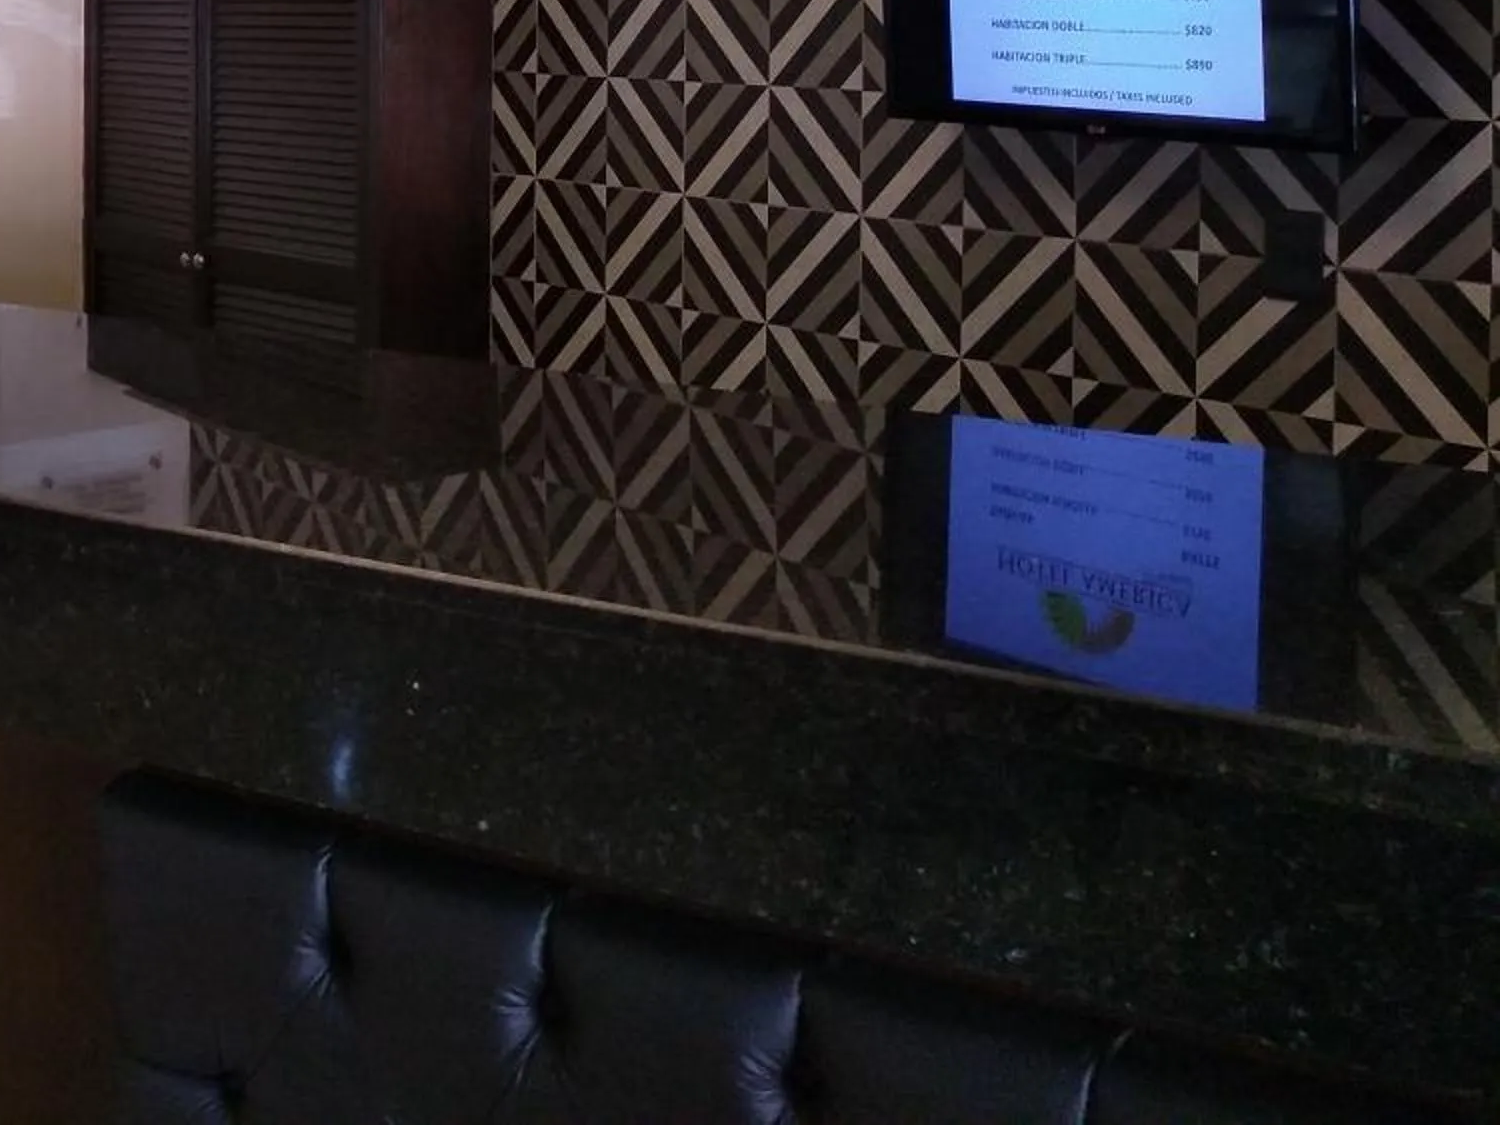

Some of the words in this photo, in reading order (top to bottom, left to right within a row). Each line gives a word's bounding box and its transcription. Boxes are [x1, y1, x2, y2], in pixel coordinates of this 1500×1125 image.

[1051, 20, 1085, 32] DOBLE
[1184, 24, 1213, 37] $820
[991, 50, 1051, 64] HABITACION
[1052, 52, 1086, 65] TRIPLE
